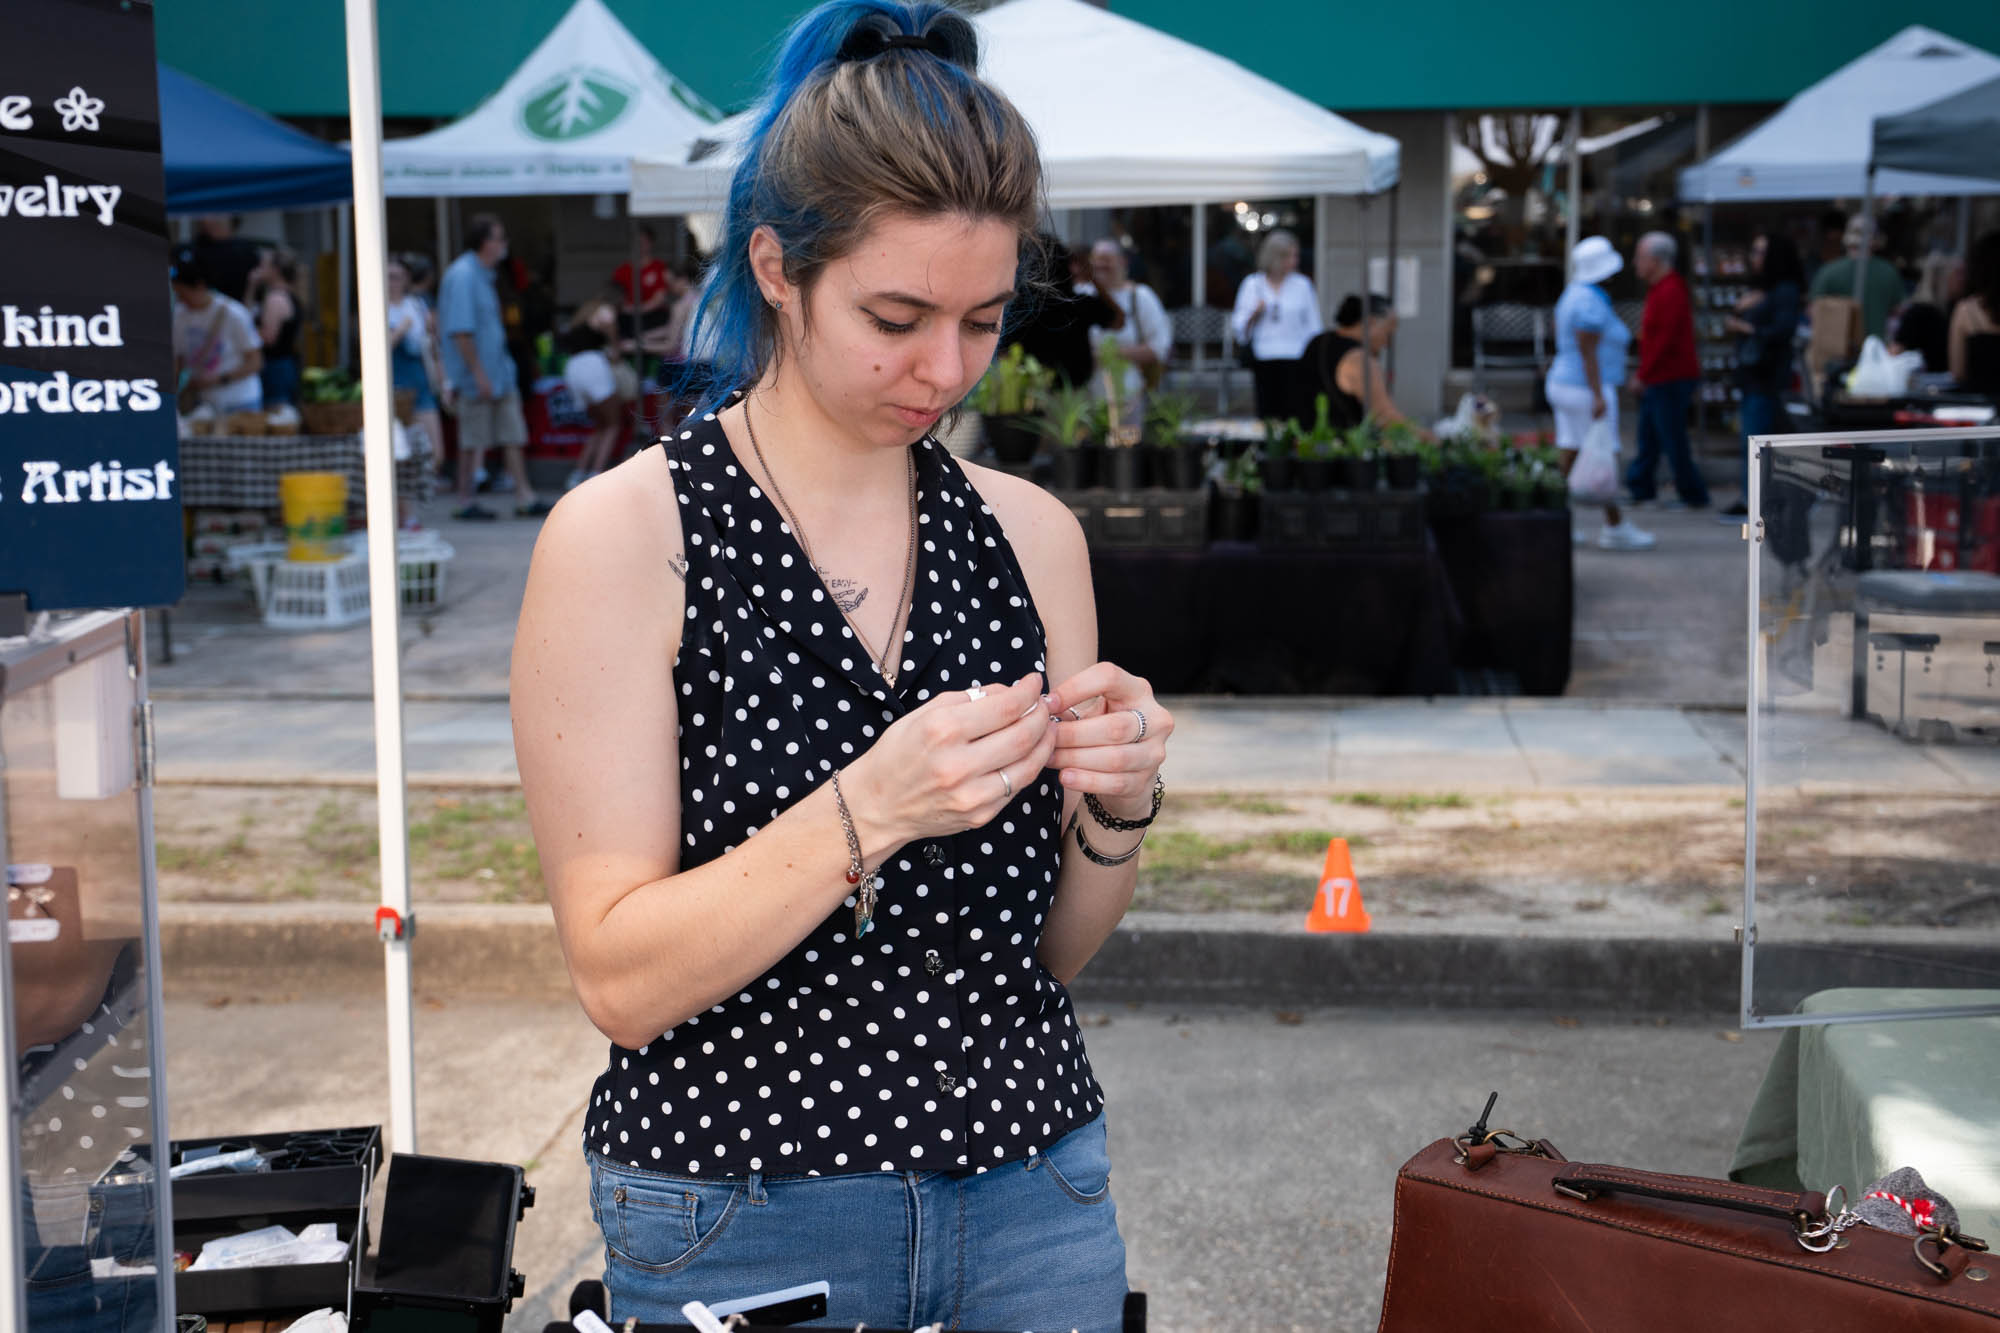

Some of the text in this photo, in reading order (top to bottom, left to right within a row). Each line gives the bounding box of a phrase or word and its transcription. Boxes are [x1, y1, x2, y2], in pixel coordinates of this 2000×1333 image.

[0, 95, 34, 130] e
[1, 305, 124, 347] kind
[21, 460, 176, 504] Artist
[1320, 878, 1352, 917] 17
